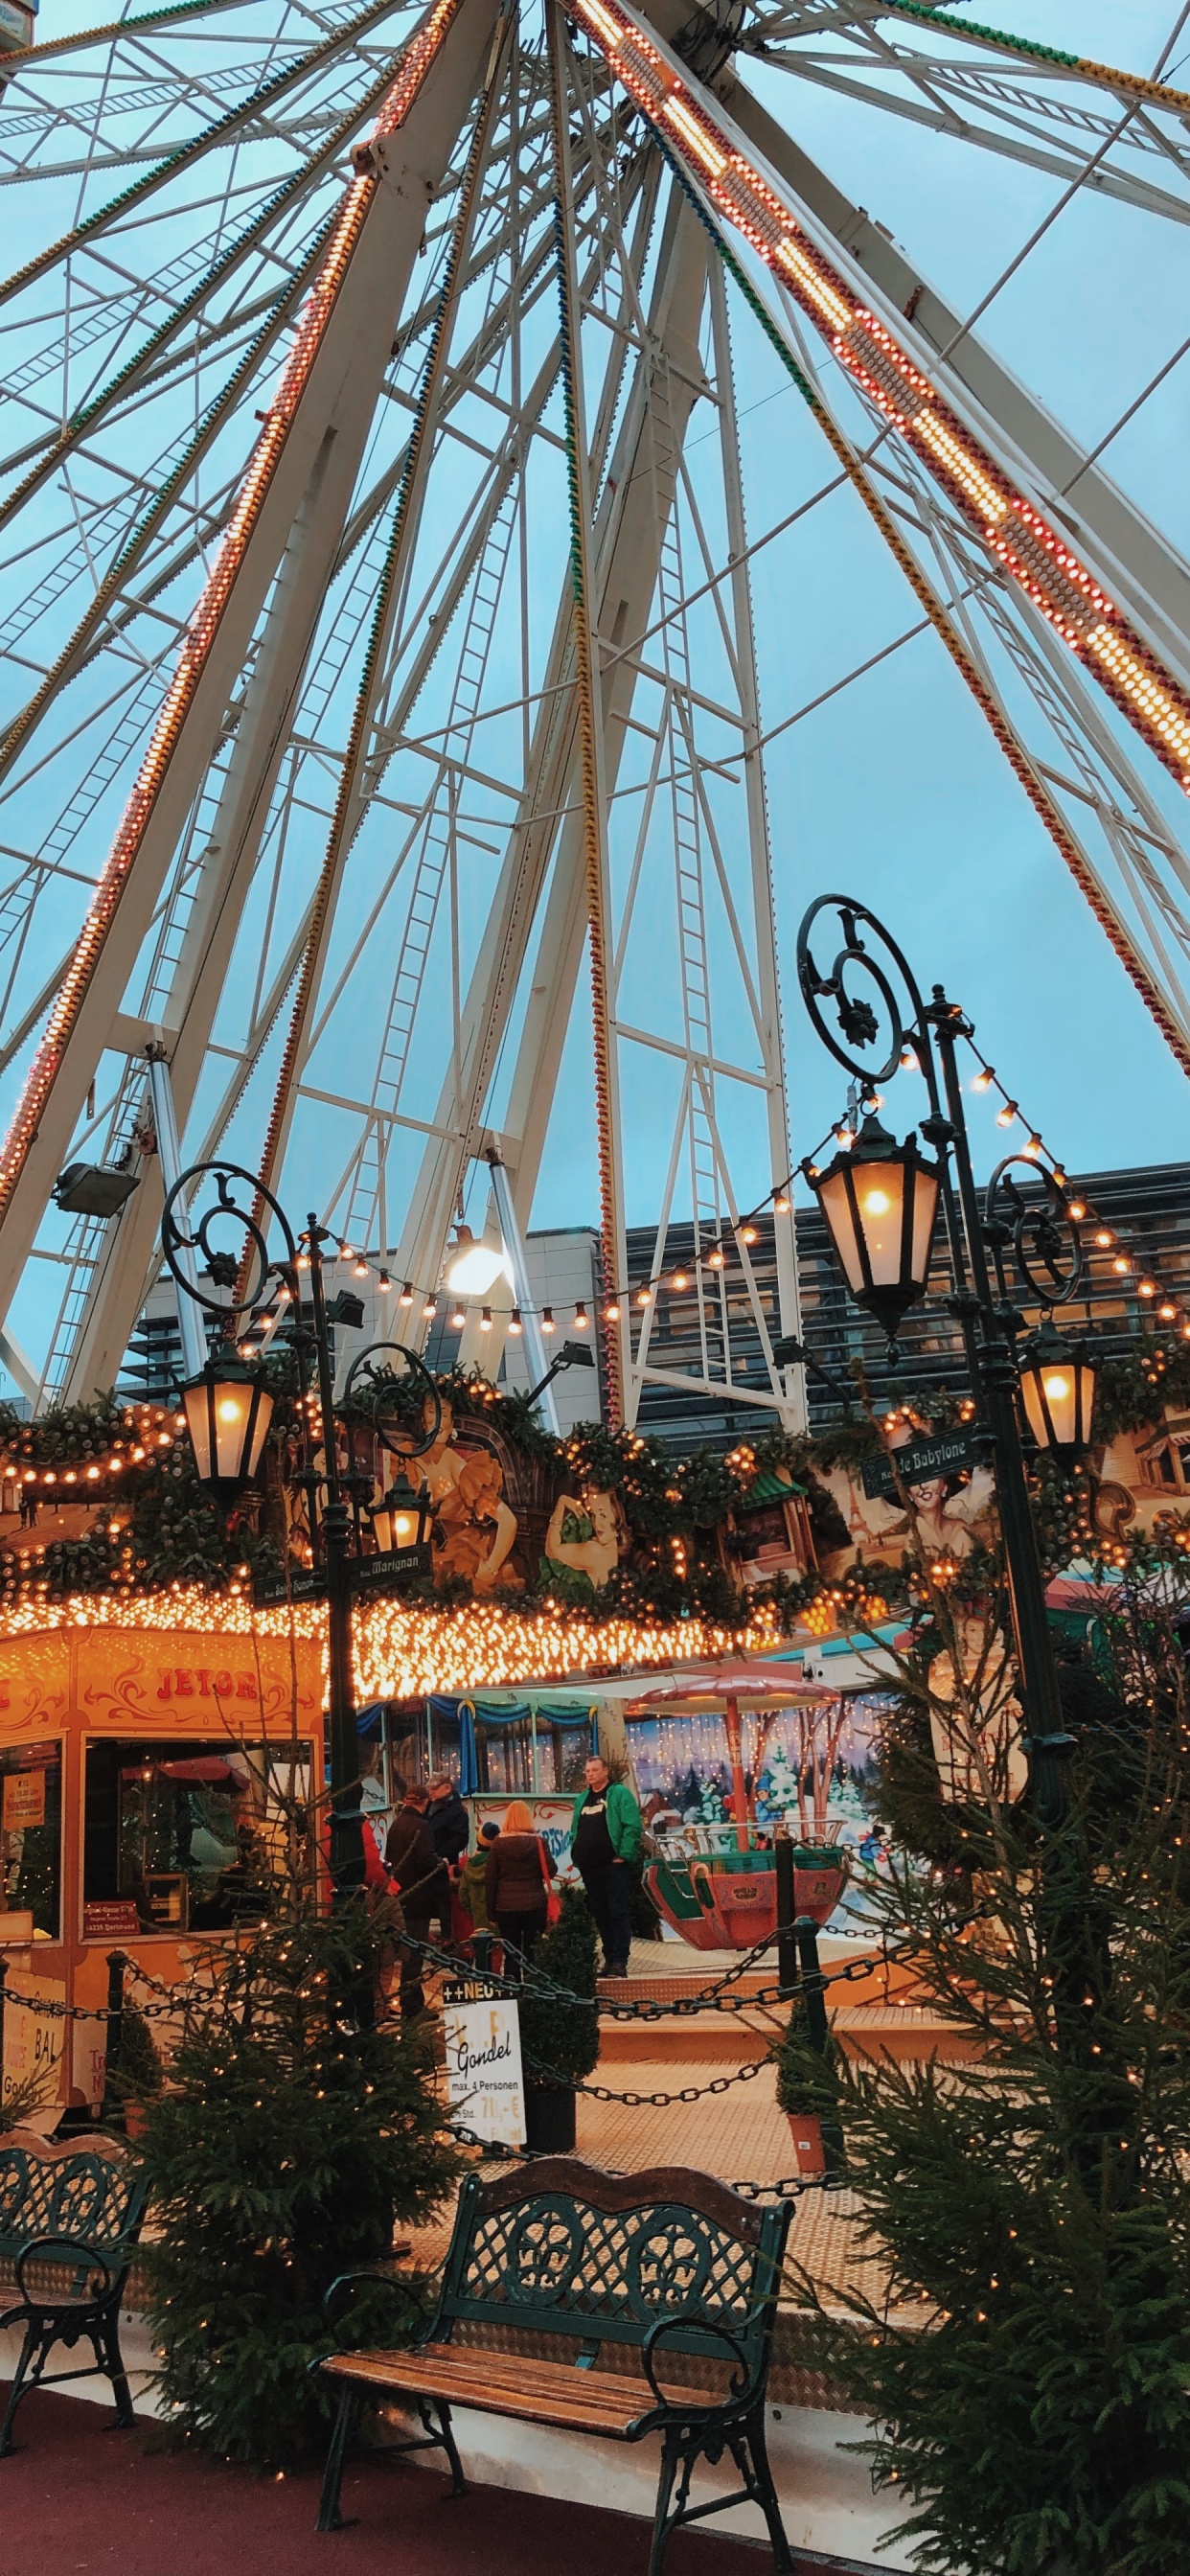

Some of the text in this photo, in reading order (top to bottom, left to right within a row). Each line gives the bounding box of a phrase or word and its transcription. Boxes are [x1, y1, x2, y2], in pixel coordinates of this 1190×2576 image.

[913, 1441, 967, 1469] Babylone
[372, 1555, 419, 1575] Marignan
[34, 2027, 57, 2063] BAL
[457, 2030, 512, 2081] Gondel
[451, 2080, 518, 2091] max. 4 Personen
